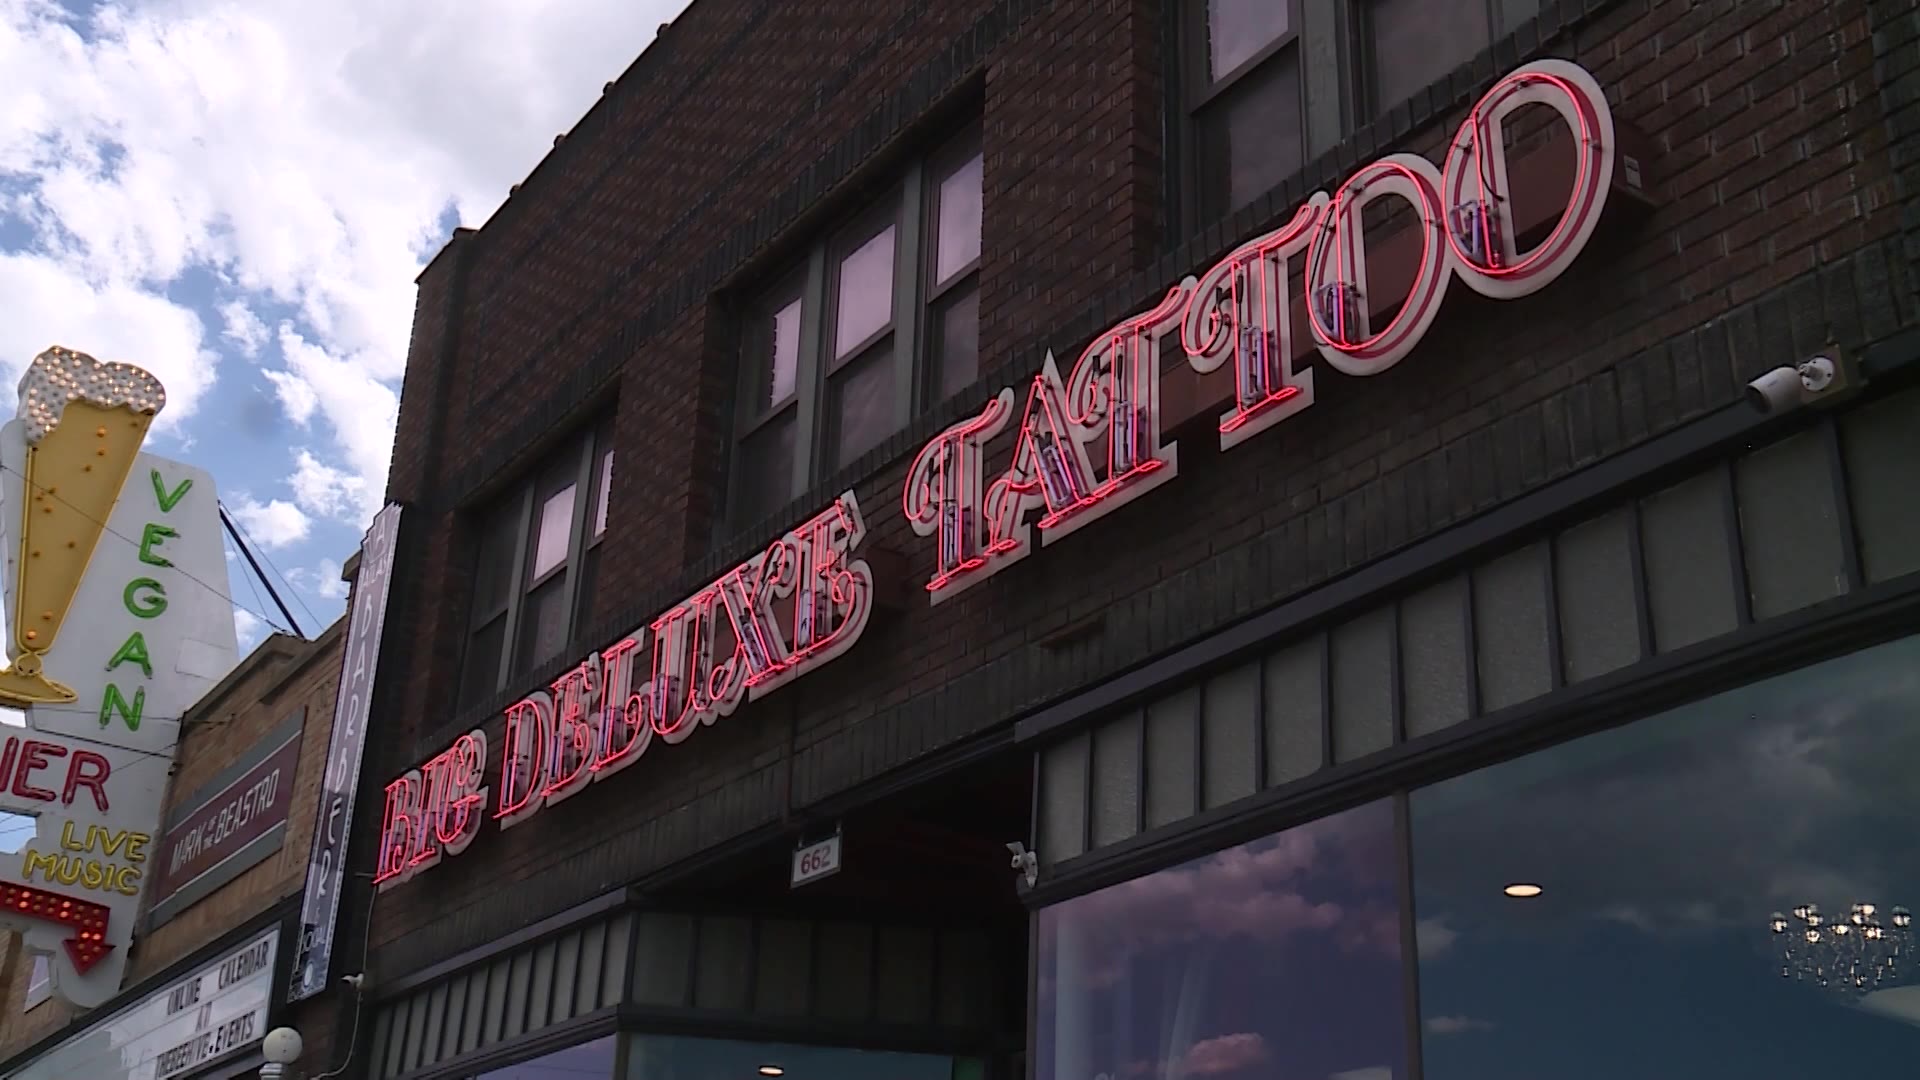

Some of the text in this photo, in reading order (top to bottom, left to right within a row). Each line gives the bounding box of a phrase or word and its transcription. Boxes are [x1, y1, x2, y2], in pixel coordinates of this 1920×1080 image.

[373, 58, 1616, 892] BIG DELUXE TATTOO
[99, 468, 193, 732] VEGAN
[60, 820, 150, 862] LIVE
[169, 821, 207, 876] MARK
[214, 767, 280, 845] BEASTRO
[22, 849, 142, 896] MUSIC
[800, 844, 832, 875] 662
[167, 941, 269, 1016] ONLINE CALENDAR
